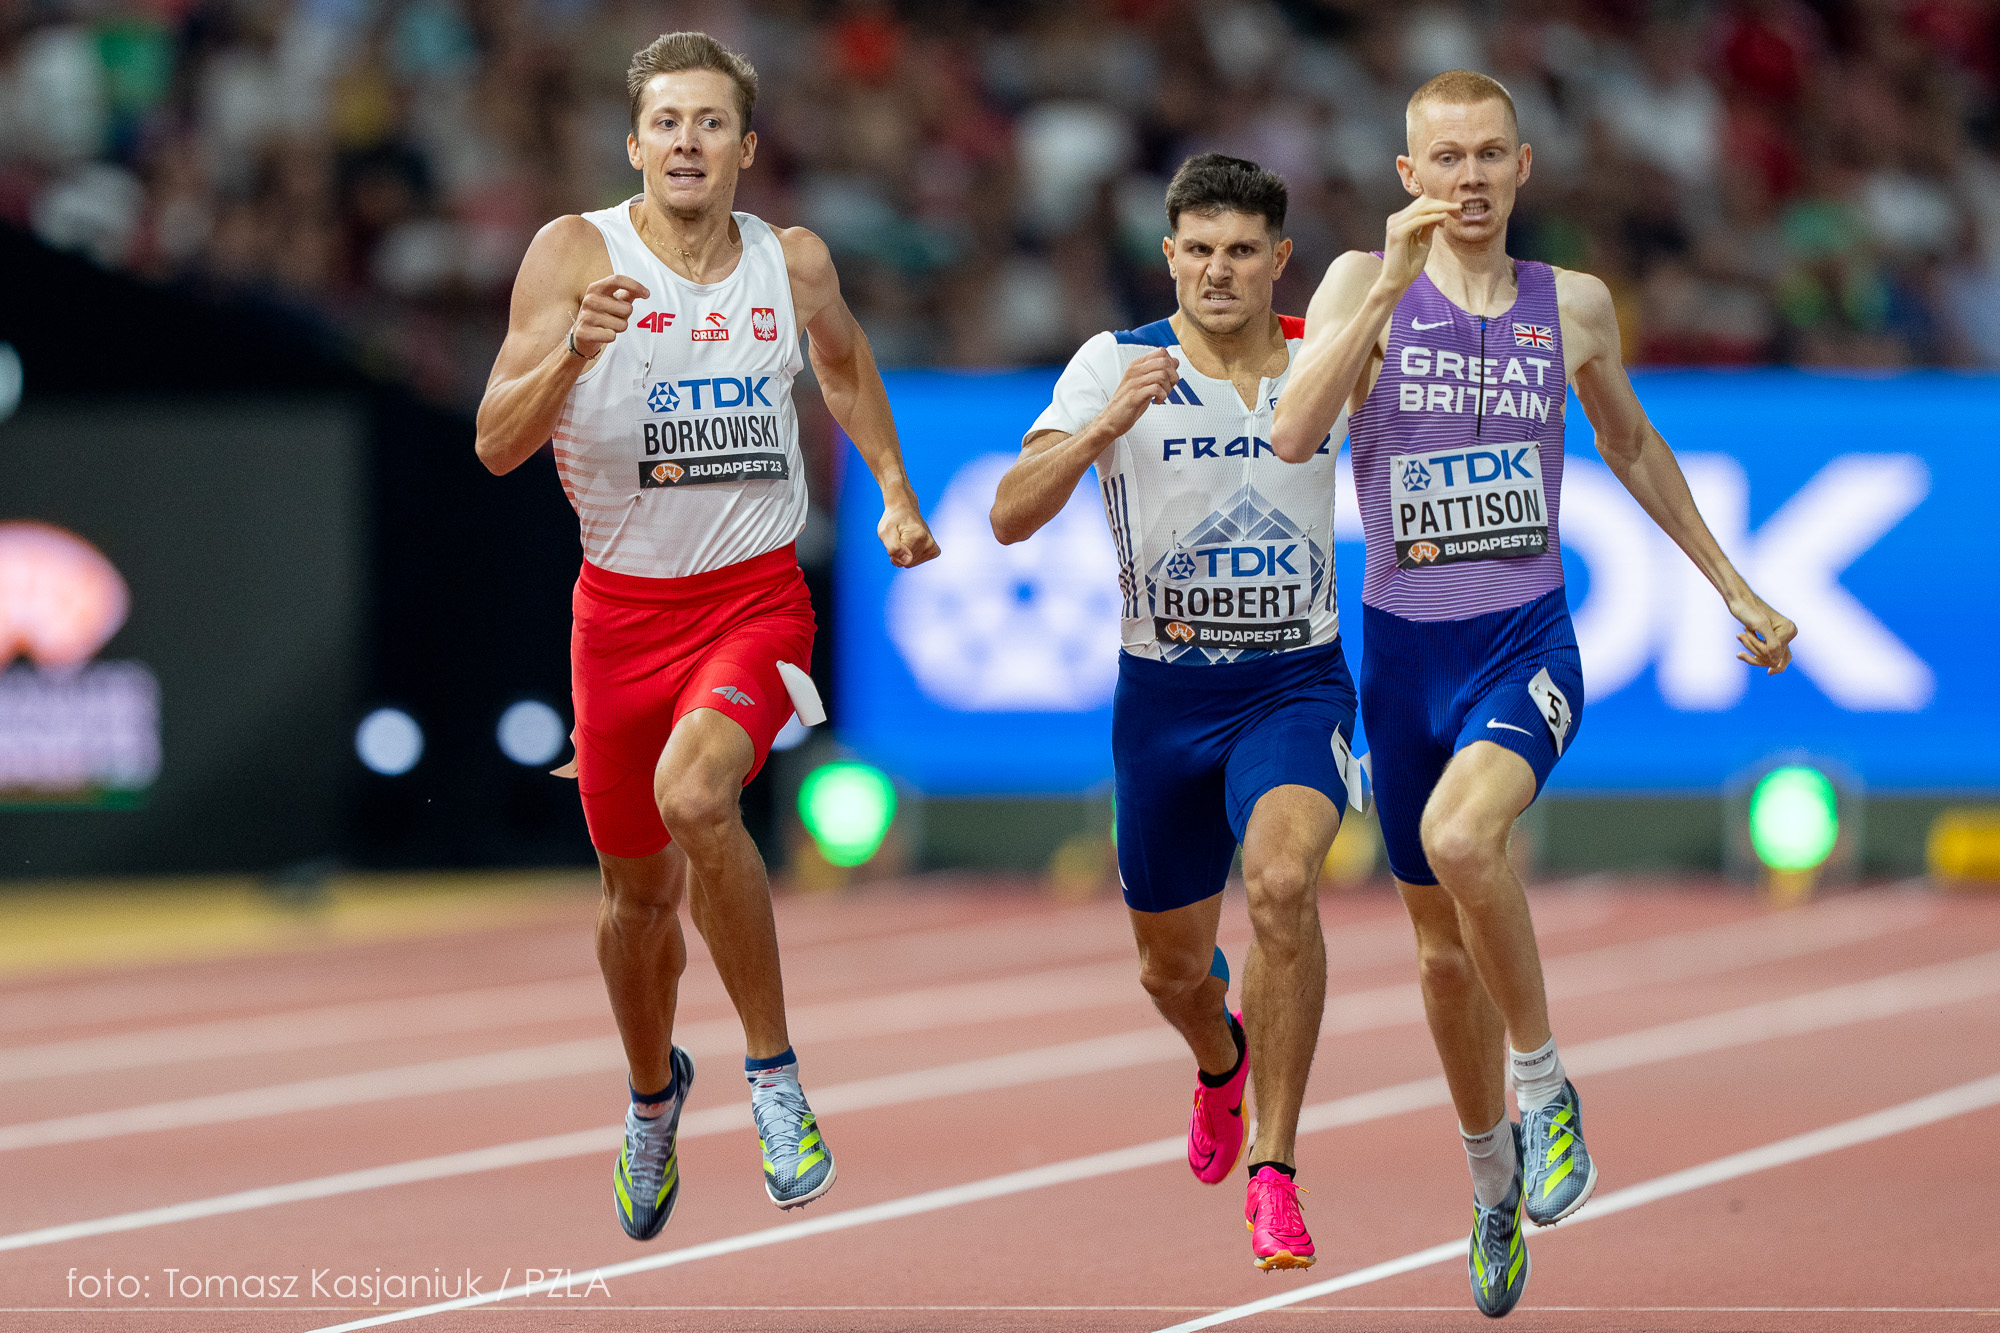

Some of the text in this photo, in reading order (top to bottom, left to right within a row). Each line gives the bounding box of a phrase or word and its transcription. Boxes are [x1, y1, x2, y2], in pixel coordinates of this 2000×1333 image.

[637, 311, 676, 334] 4F
[692, 330, 727, 340] ORLEN
[1400, 346, 1551, 386] GREAT
[677, 376, 773, 411] TDK
[1399, 383, 1551, 424] BRITAIN
[643, 415, 779, 456] BORKOWSKI
[1163, 432, 1331, 462] FRAN
[689, 460, 783, 477] BUDAPEST 23
[1429, 447, 1534, 487] TDK
[1400, 489, 1541, 537] PATTISON
[1445, 531, 1543, 556] BUDAPEST 23
[1196, 544, 1300, 578] TDK
[1163, 584, 1302, 618] ROBERT
[1200, 627, 1302, 643] BUDAPEST 23
[712, 686, 755, 707] 4F
[1547, 690, 1563, 728] 5
